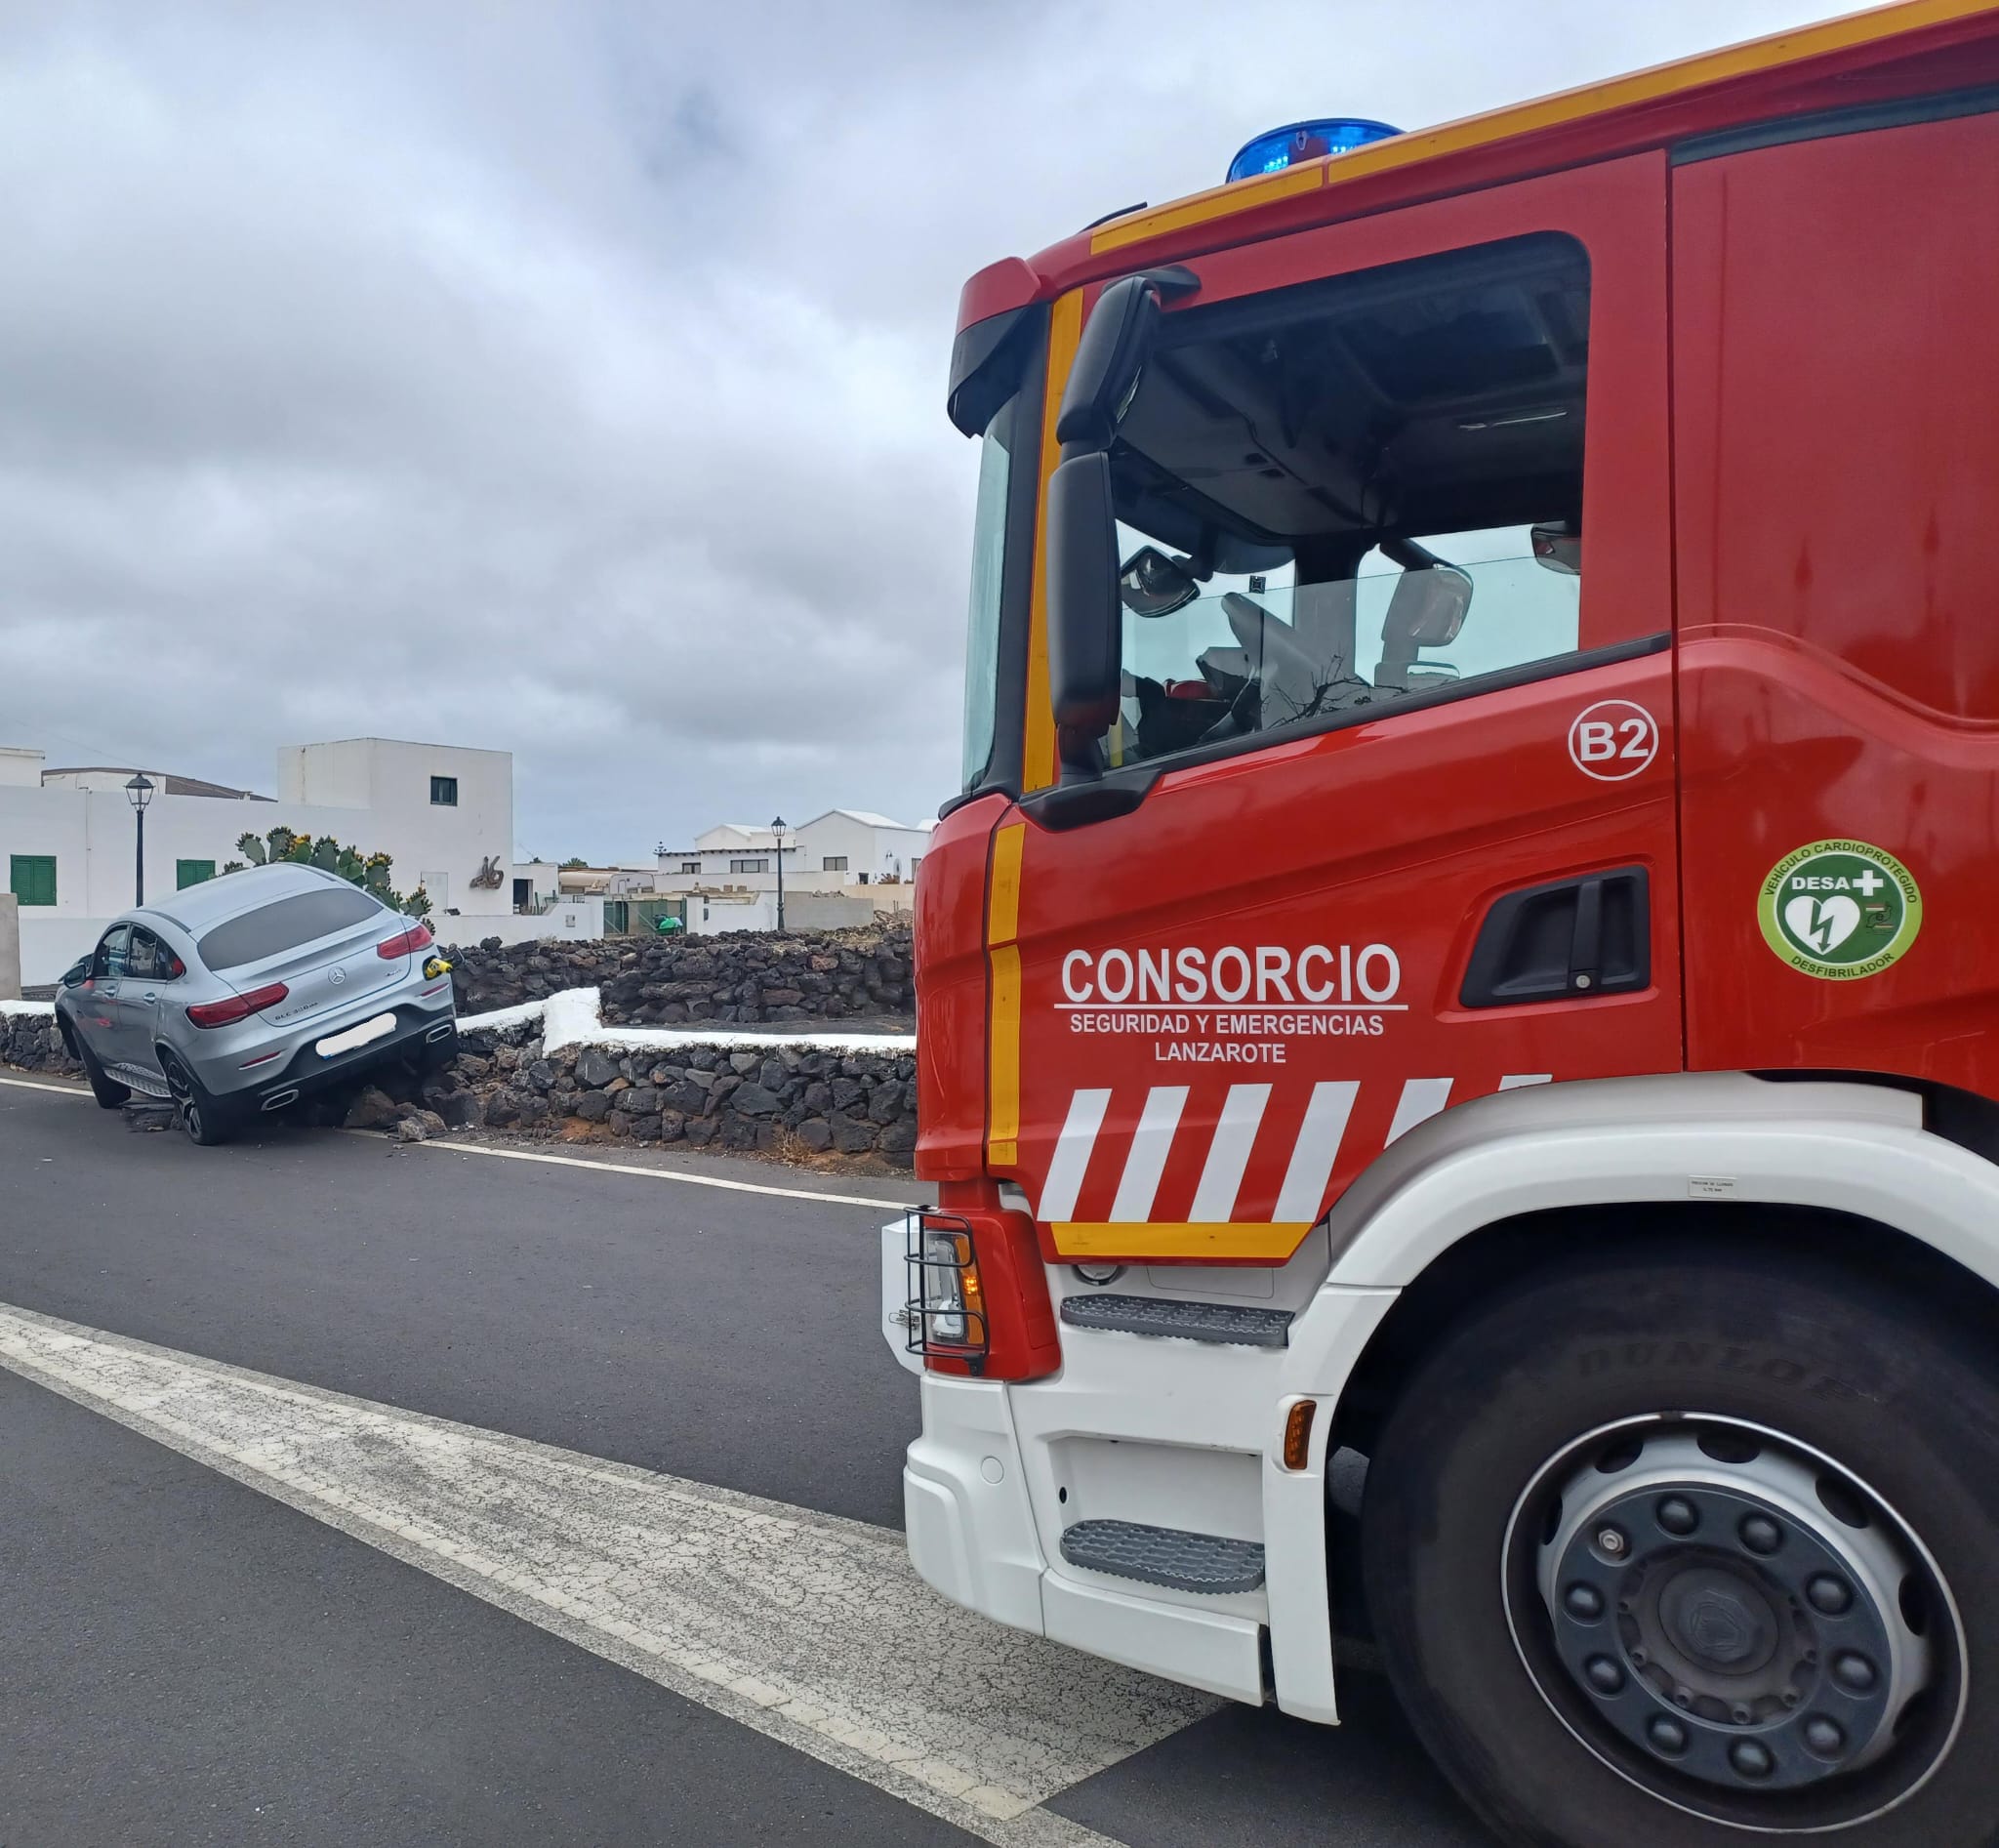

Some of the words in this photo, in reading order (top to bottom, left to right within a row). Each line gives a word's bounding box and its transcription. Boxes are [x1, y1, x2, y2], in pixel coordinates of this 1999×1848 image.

[1579, 718, 1650, 761] B2
[1791, 876, 1851, 890] DESA
[1814, 842, 1918, 904] CARDIOPROTEGIDO
[1061, 943, 1402, 1003] CONSORCIO
[1790, 952, 1896, 978] DESFIBRILADOR
[1070, 1013, 1191, 1034] SEGURIDAD
[1196, 1014, 1209, 1034] Y
[1215, 1014, 1384, 1036] EMERGENCIAS
[1155, 1042, 1286, 1063] LANZAROTE
